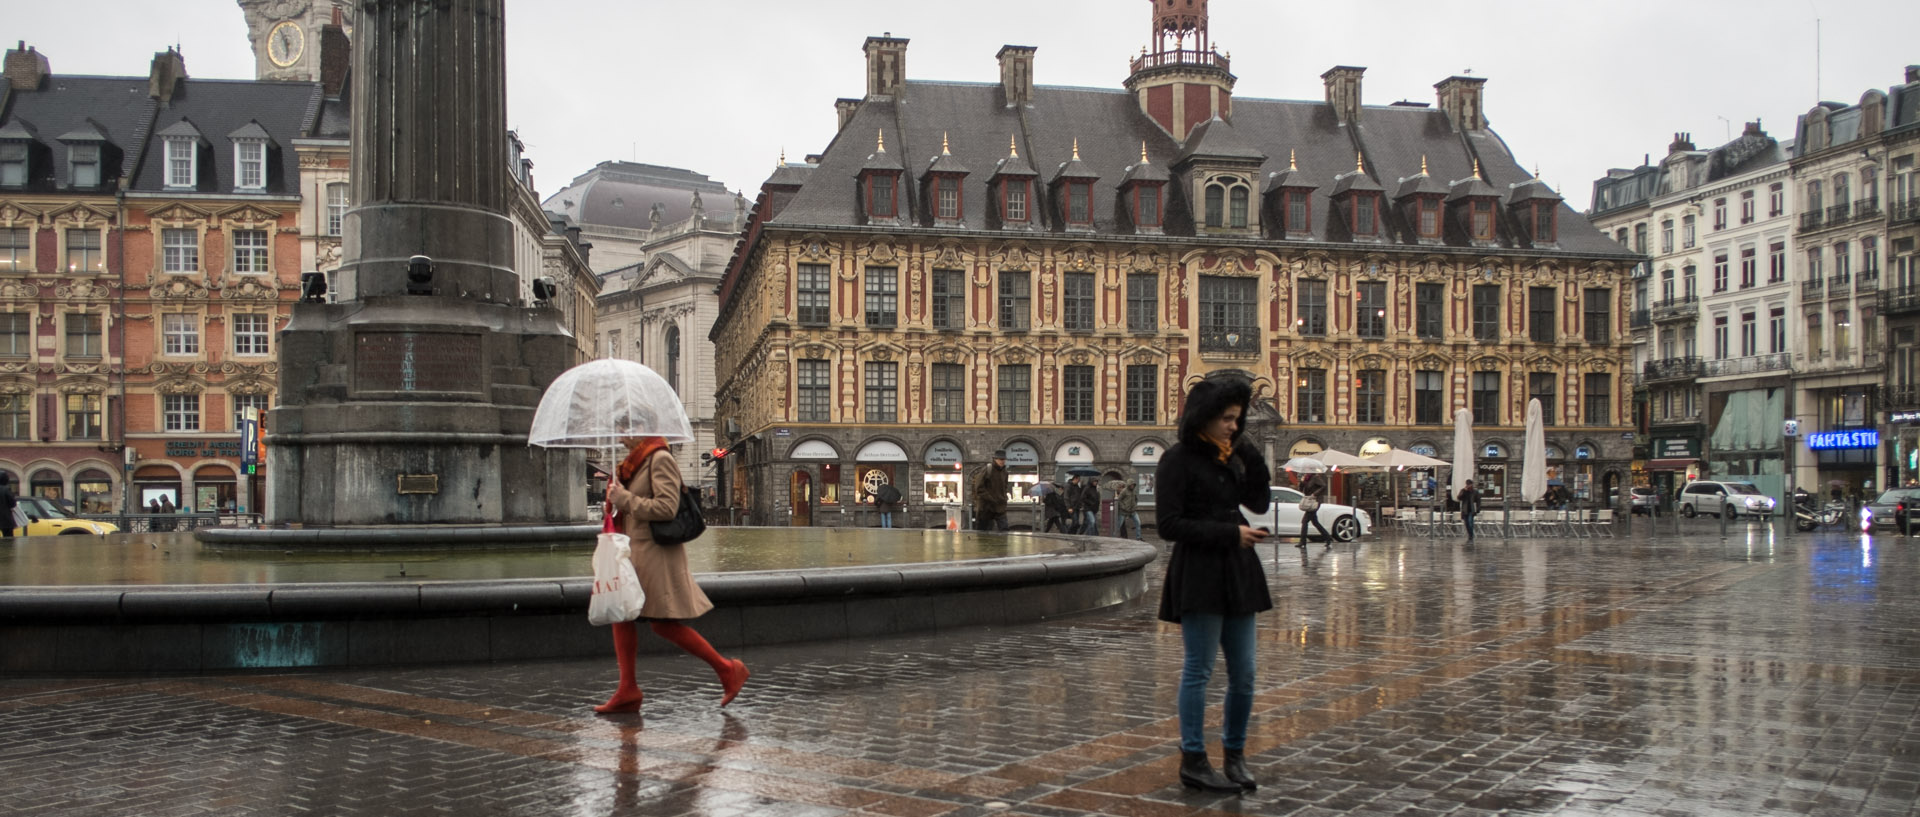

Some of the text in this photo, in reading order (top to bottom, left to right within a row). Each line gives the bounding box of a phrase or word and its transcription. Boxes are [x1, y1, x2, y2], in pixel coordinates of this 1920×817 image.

[166, 440, 205, 448] CREDIT
[166, 449, 197, 457] NORD
[201, 449, 216, 457] DE
